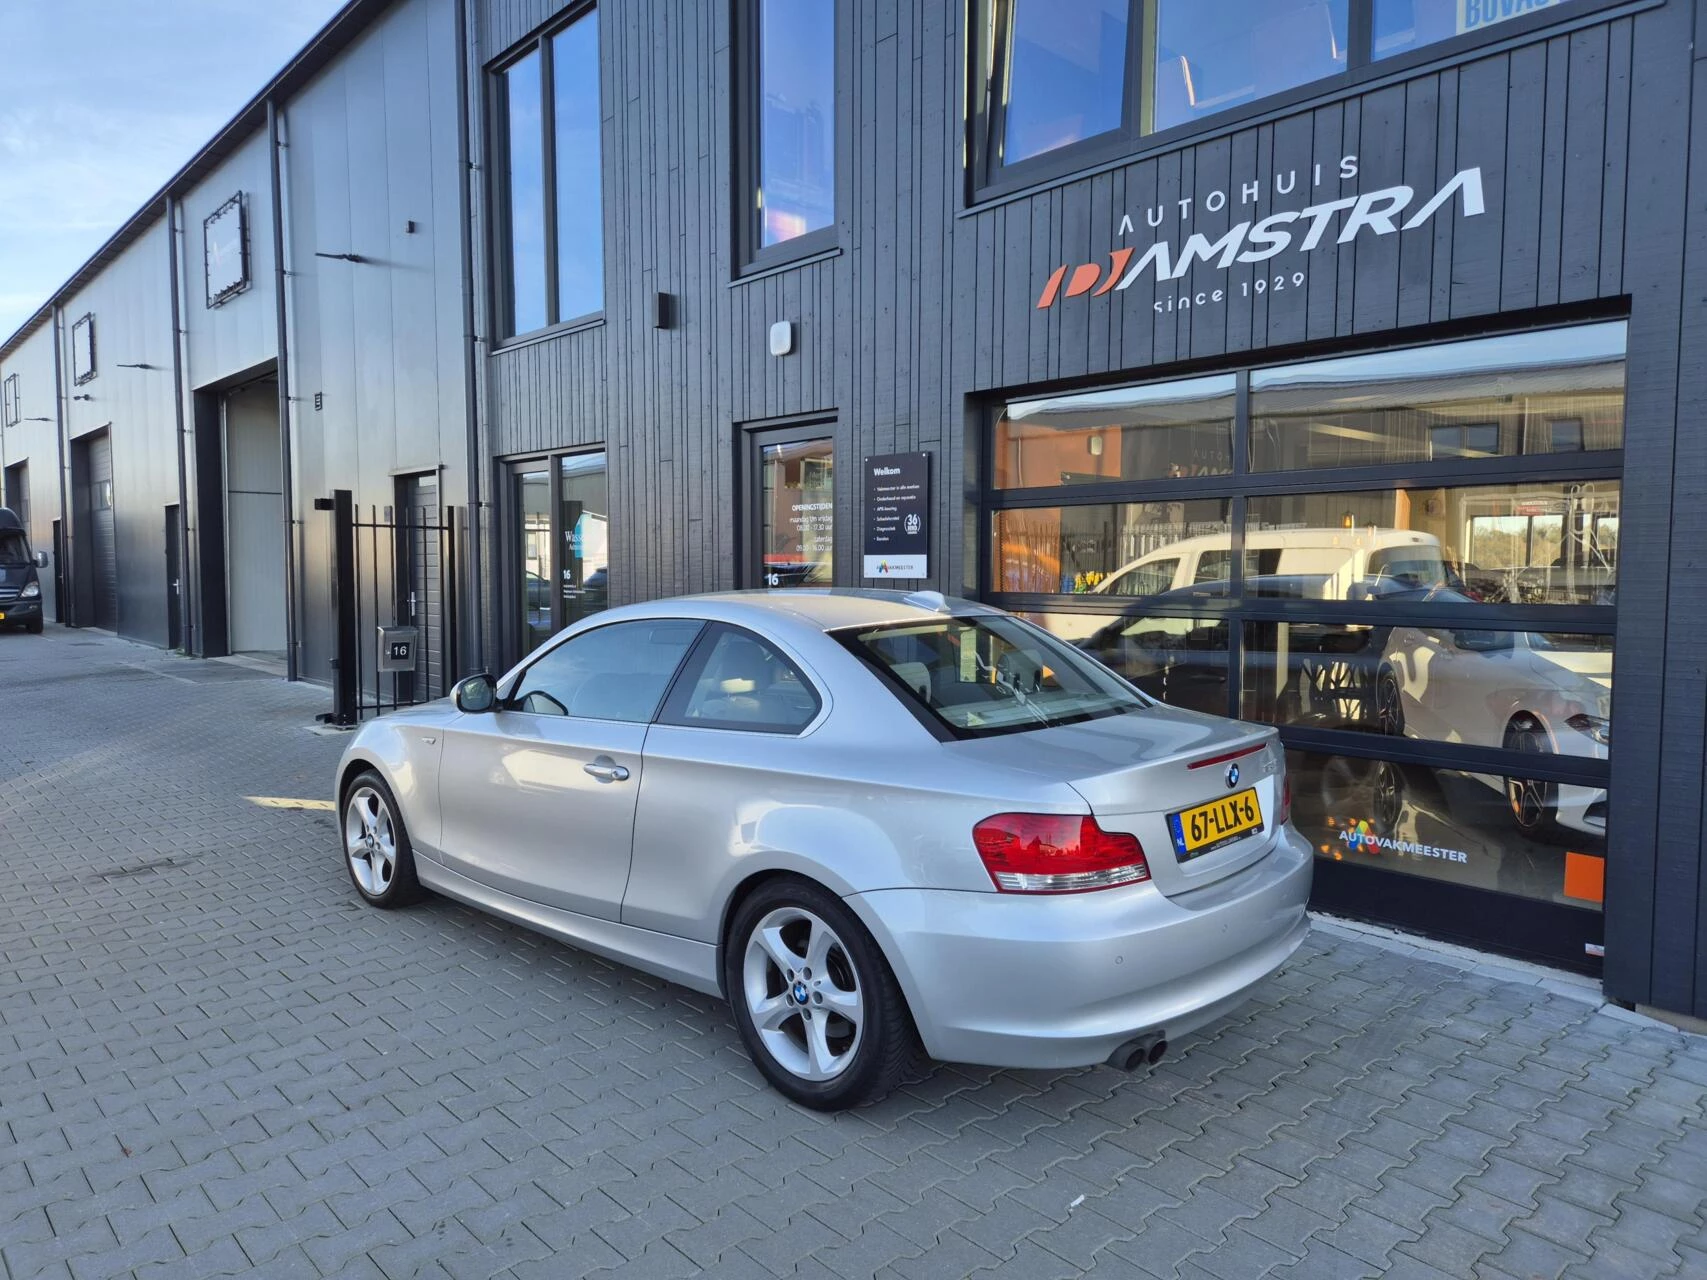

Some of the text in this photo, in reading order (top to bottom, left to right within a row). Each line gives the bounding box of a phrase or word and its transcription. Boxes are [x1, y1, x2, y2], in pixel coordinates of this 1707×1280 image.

[1118, 155, 1359, 236] AUTOHUIS
[1153, 271, 1305, 313] since 1929
[873, 466, 901, 476] Welkom
[907, 513, 918, 526] 36
[563, 569, 572, 580] 16
[767, 573, 779, 586] 16
[393, 645, 408, 656] 16
[1190, 796, 1255, 842] 67-LLX-6
[1338, 830, 1468, 864] AUTOVAKMEESTER
